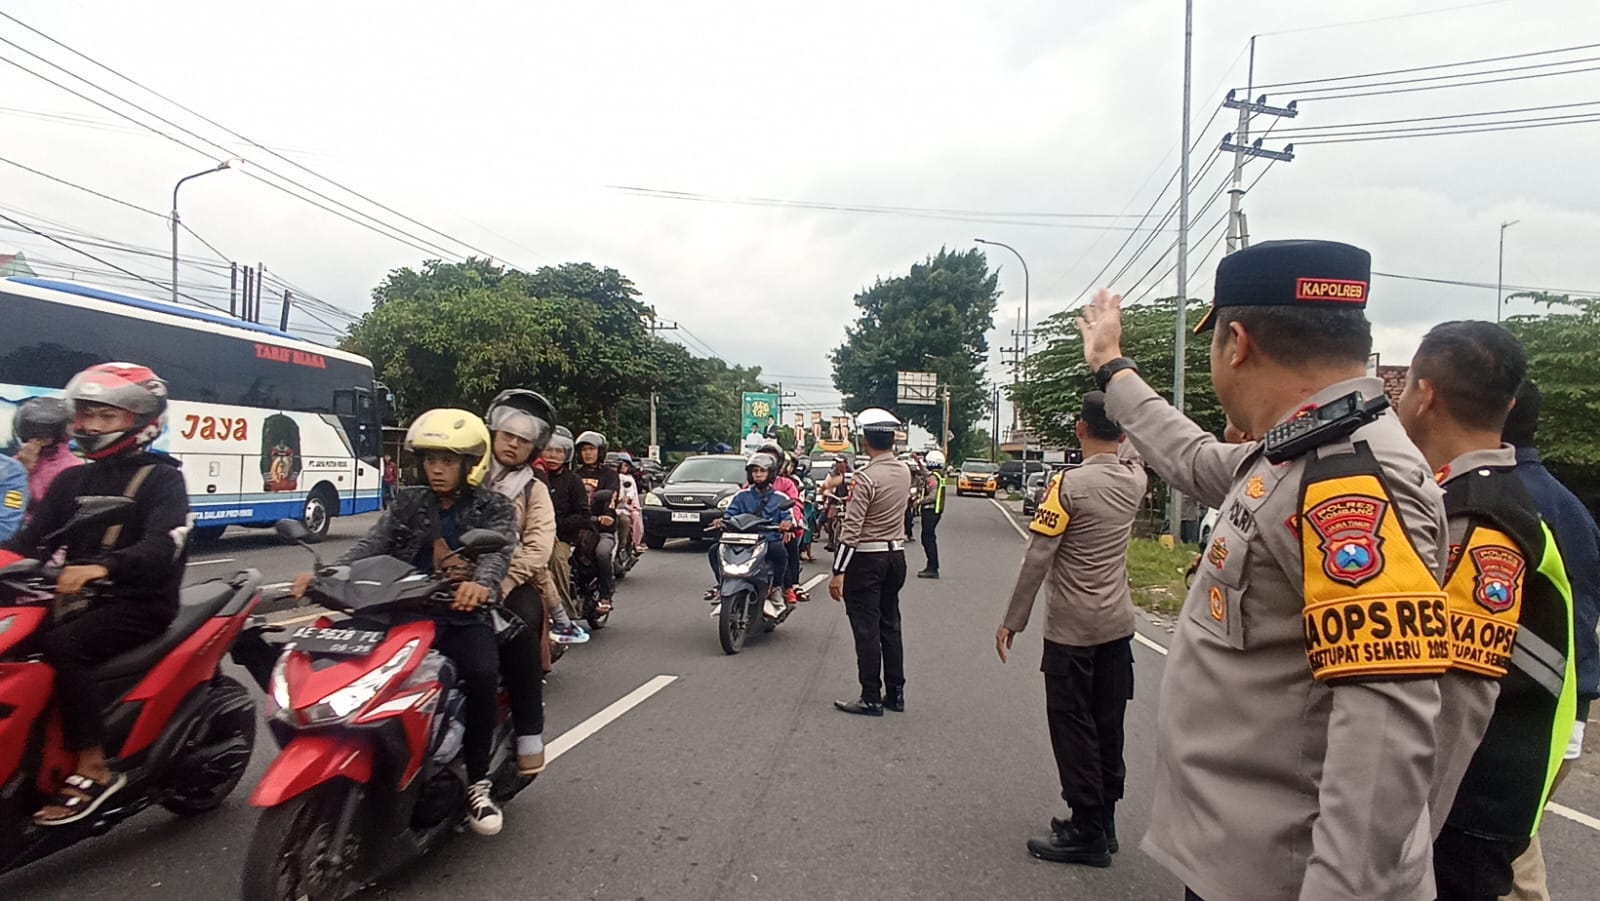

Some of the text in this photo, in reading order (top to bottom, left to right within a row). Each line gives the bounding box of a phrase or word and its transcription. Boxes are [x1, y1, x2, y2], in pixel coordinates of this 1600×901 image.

[1302, 282, 1362, 298] KAPOLRES
[255, 344, 326, 368] TARIF BIASA
[180, 414, 248, 441] Jaya
[1321, 601, 1392, 645] OPS
[1396, 599, 1447, 638] RES
[1450, 613, 1475, 644] KA
[1363, 640, 1421, 662] SEMERU
[1427, 639, 1449, 659] 2025
